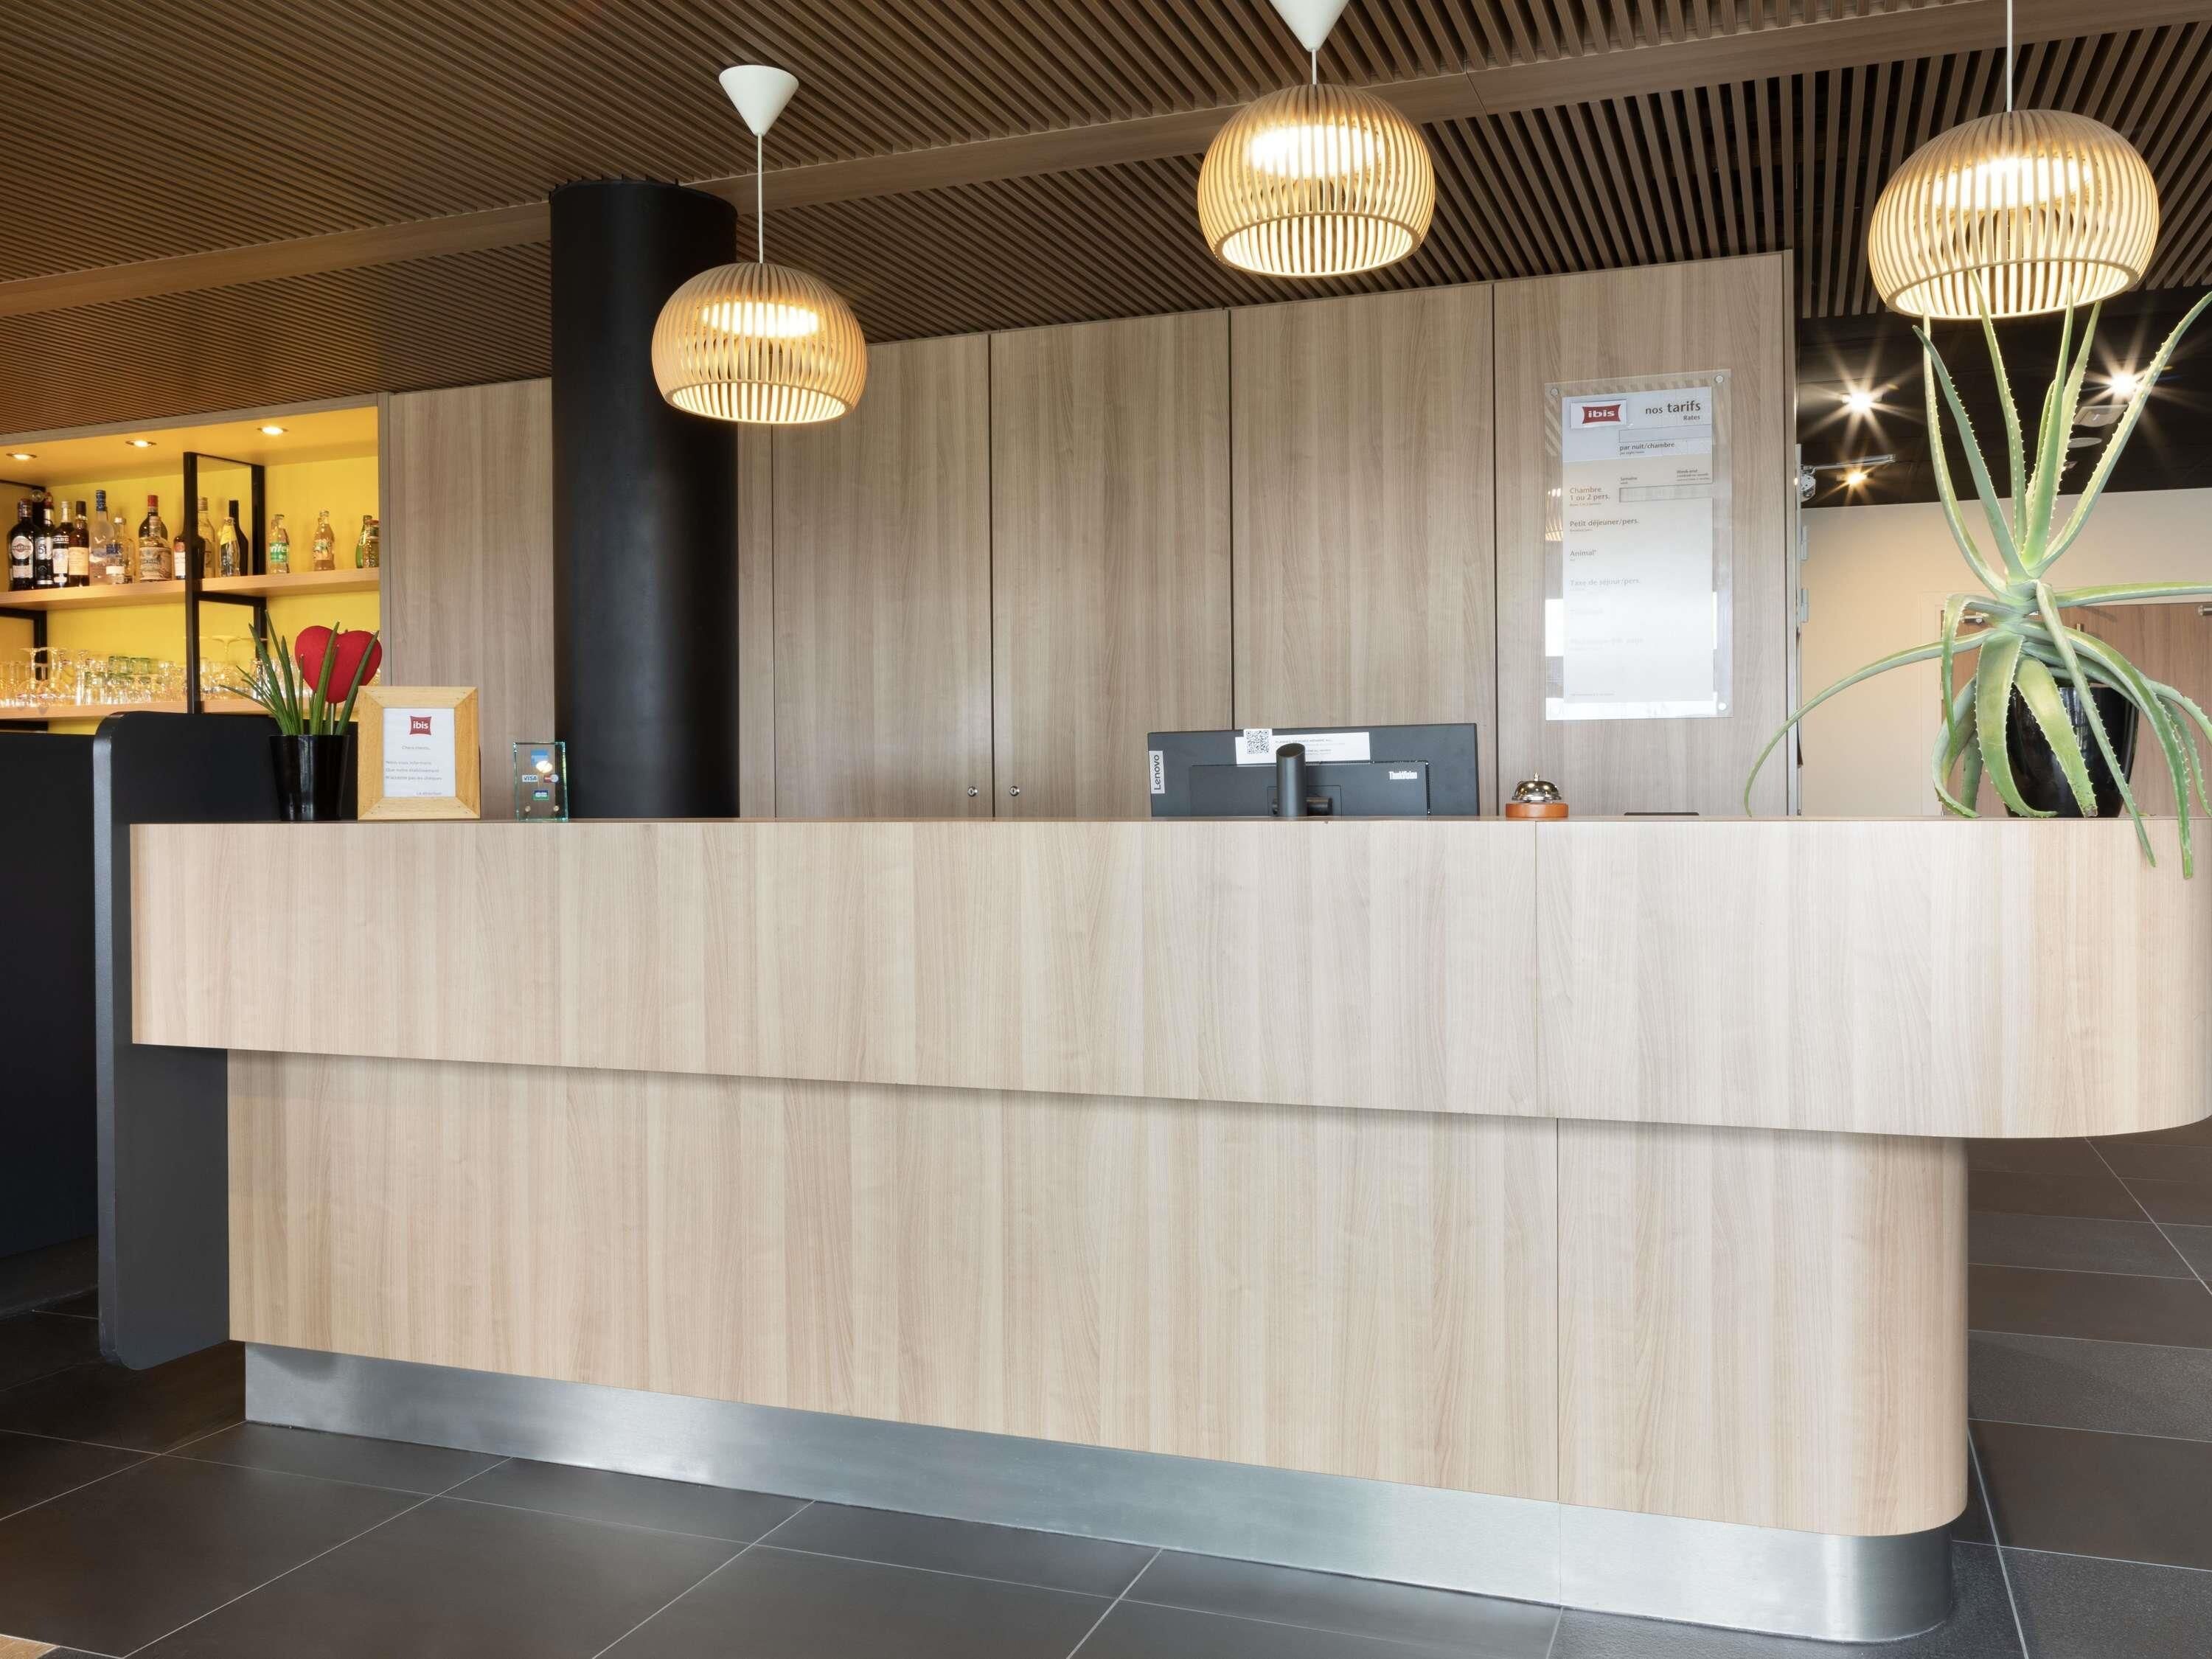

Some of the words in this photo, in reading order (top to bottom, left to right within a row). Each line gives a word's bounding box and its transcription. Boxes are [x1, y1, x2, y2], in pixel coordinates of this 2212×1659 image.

[1644, 406, 1663, 415] nos
[1667, 400, 1701, 413] tarifs
[1587, 409, 1615, 418] ibis
[1632, 442, 1675, 450] nuit/chambre
[1569, 486, 1602, 494] Chambre
[1593, 493, 1610, 502] pers.
[1569, 519, 1587, 527] Petit
[38, 543, 47, 554] 51
[1588, 578, 1598, 586] de
[413, 720, 429, 729] ibis
[1153, 754, 1162, 790] Lenovo
[1388, 770, 1418, 780] ThinkVision
